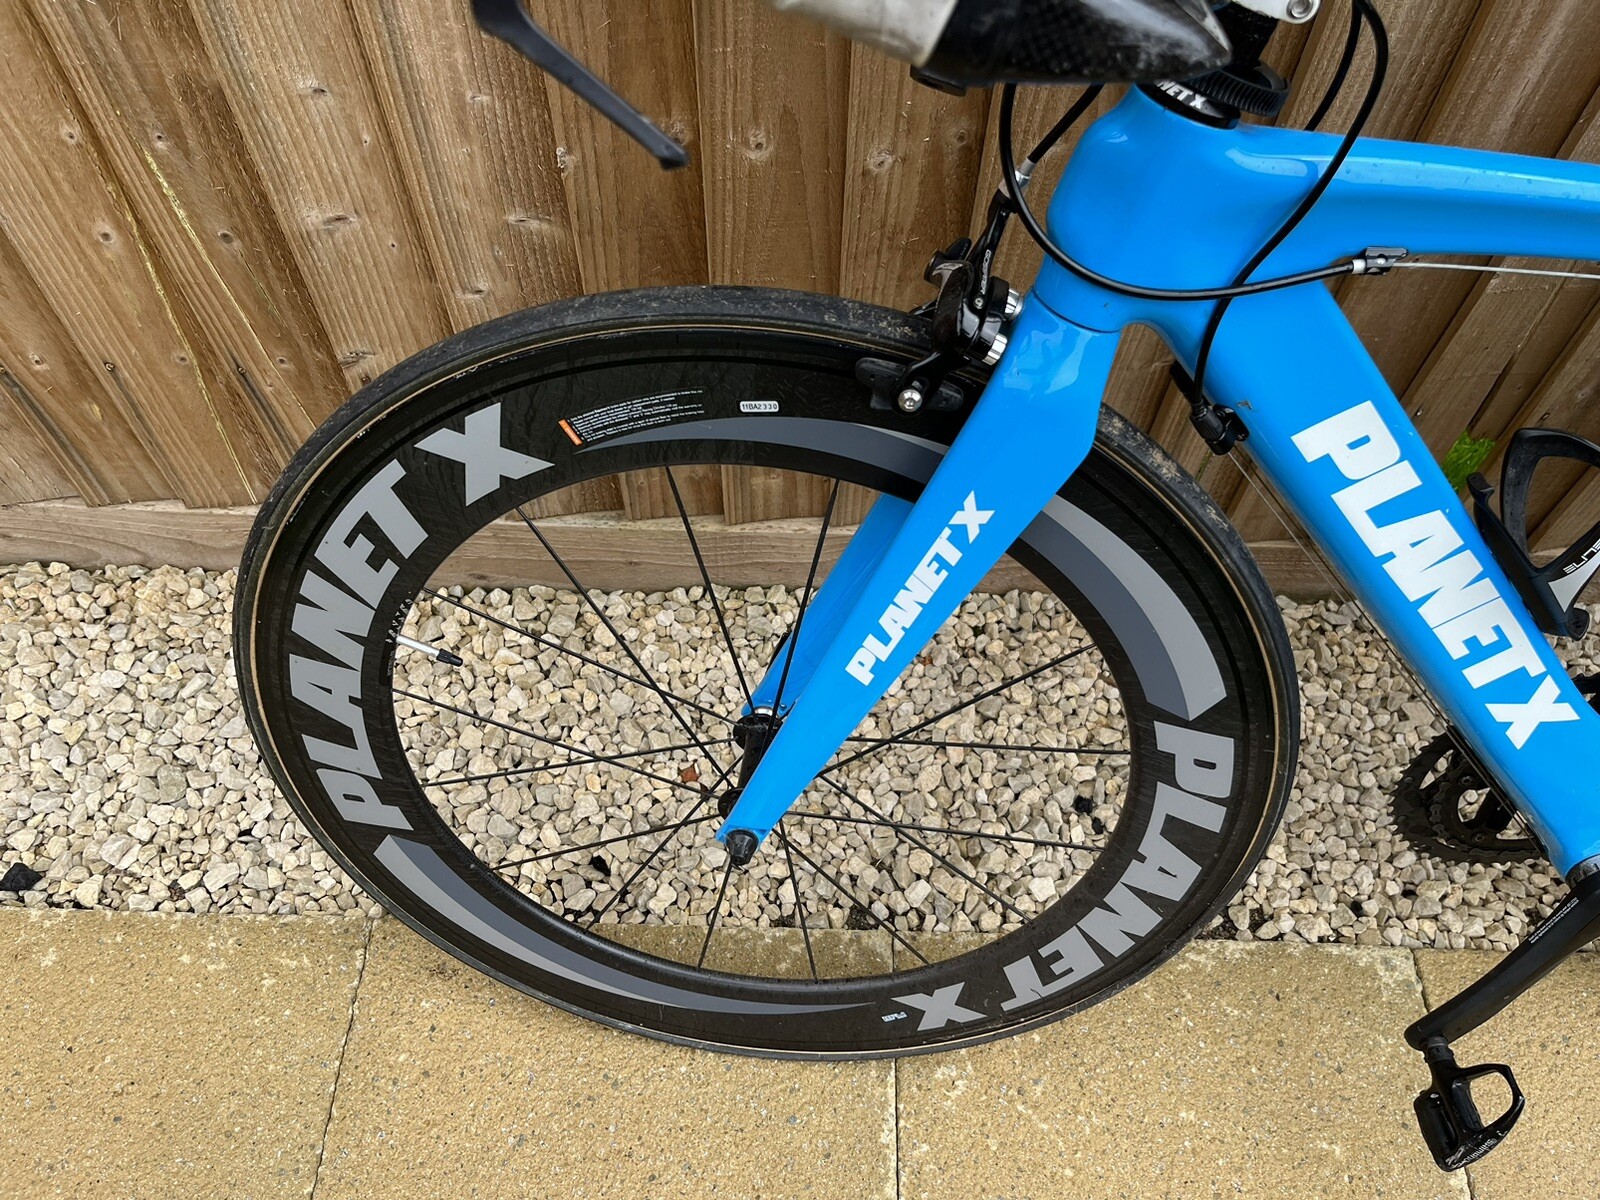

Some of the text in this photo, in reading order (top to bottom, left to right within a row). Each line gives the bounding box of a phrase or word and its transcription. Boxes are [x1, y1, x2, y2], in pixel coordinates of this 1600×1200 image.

[1189, 94, 1207, 109] X
[289, 402, 555, 830] PLANET X
[845, 490, 995, 687] PLANET X
[1290, 400, 1581, 750] PLANET X
[890, 721, 1234, 1032] PLANET X
